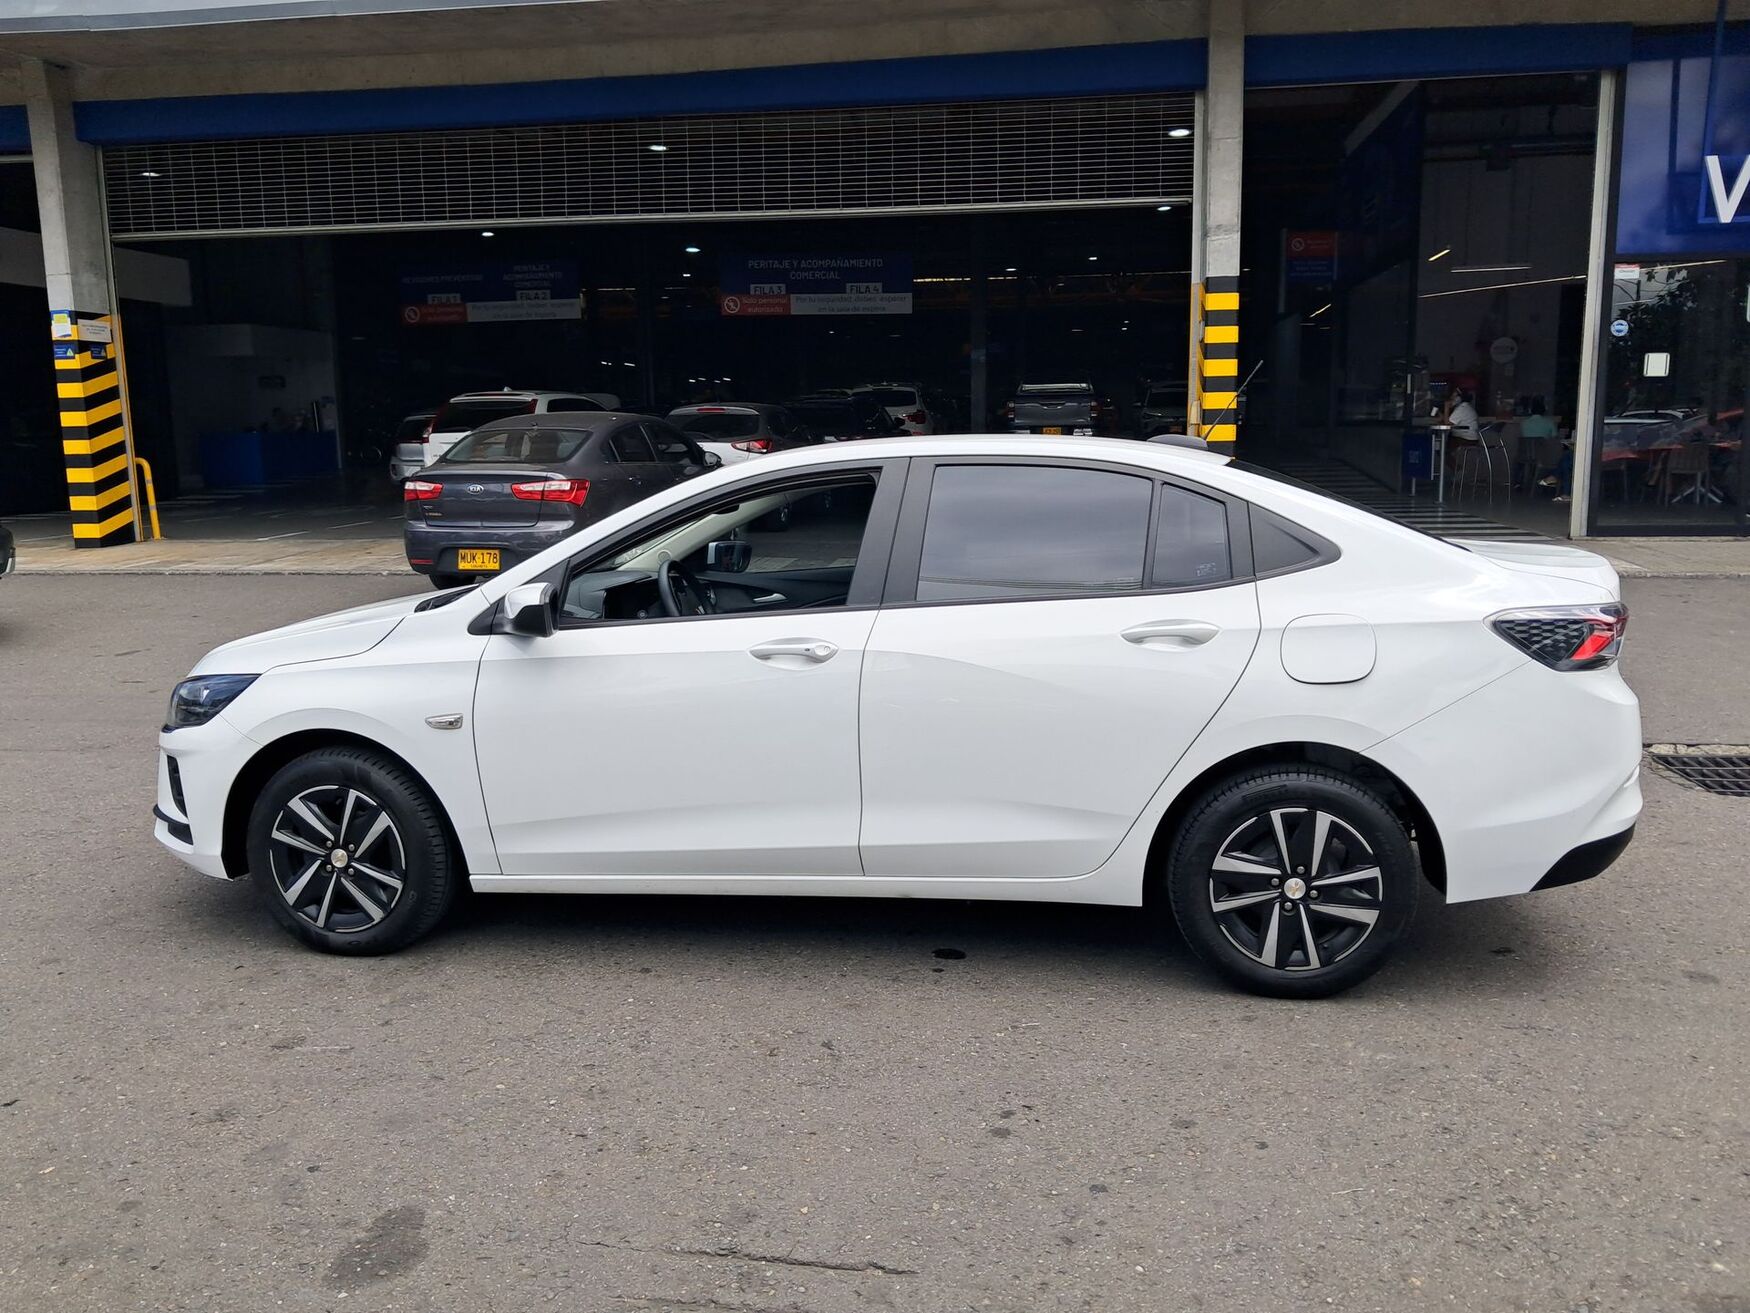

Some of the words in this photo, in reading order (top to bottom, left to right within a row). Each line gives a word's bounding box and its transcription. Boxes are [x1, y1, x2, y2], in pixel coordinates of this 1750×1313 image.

[1704, 155, 1750, 223] V
[748, 259, 790, 269] PERITAJE
[791, 259, 799, 268] Y
[801, 257, 883, 269] ACOMPAÑAMIENTO
[790, 271, 840, 280] COMERCIAL
[753, 286, 775, 295] FILA
[850, 285, 871, 294] FILA
